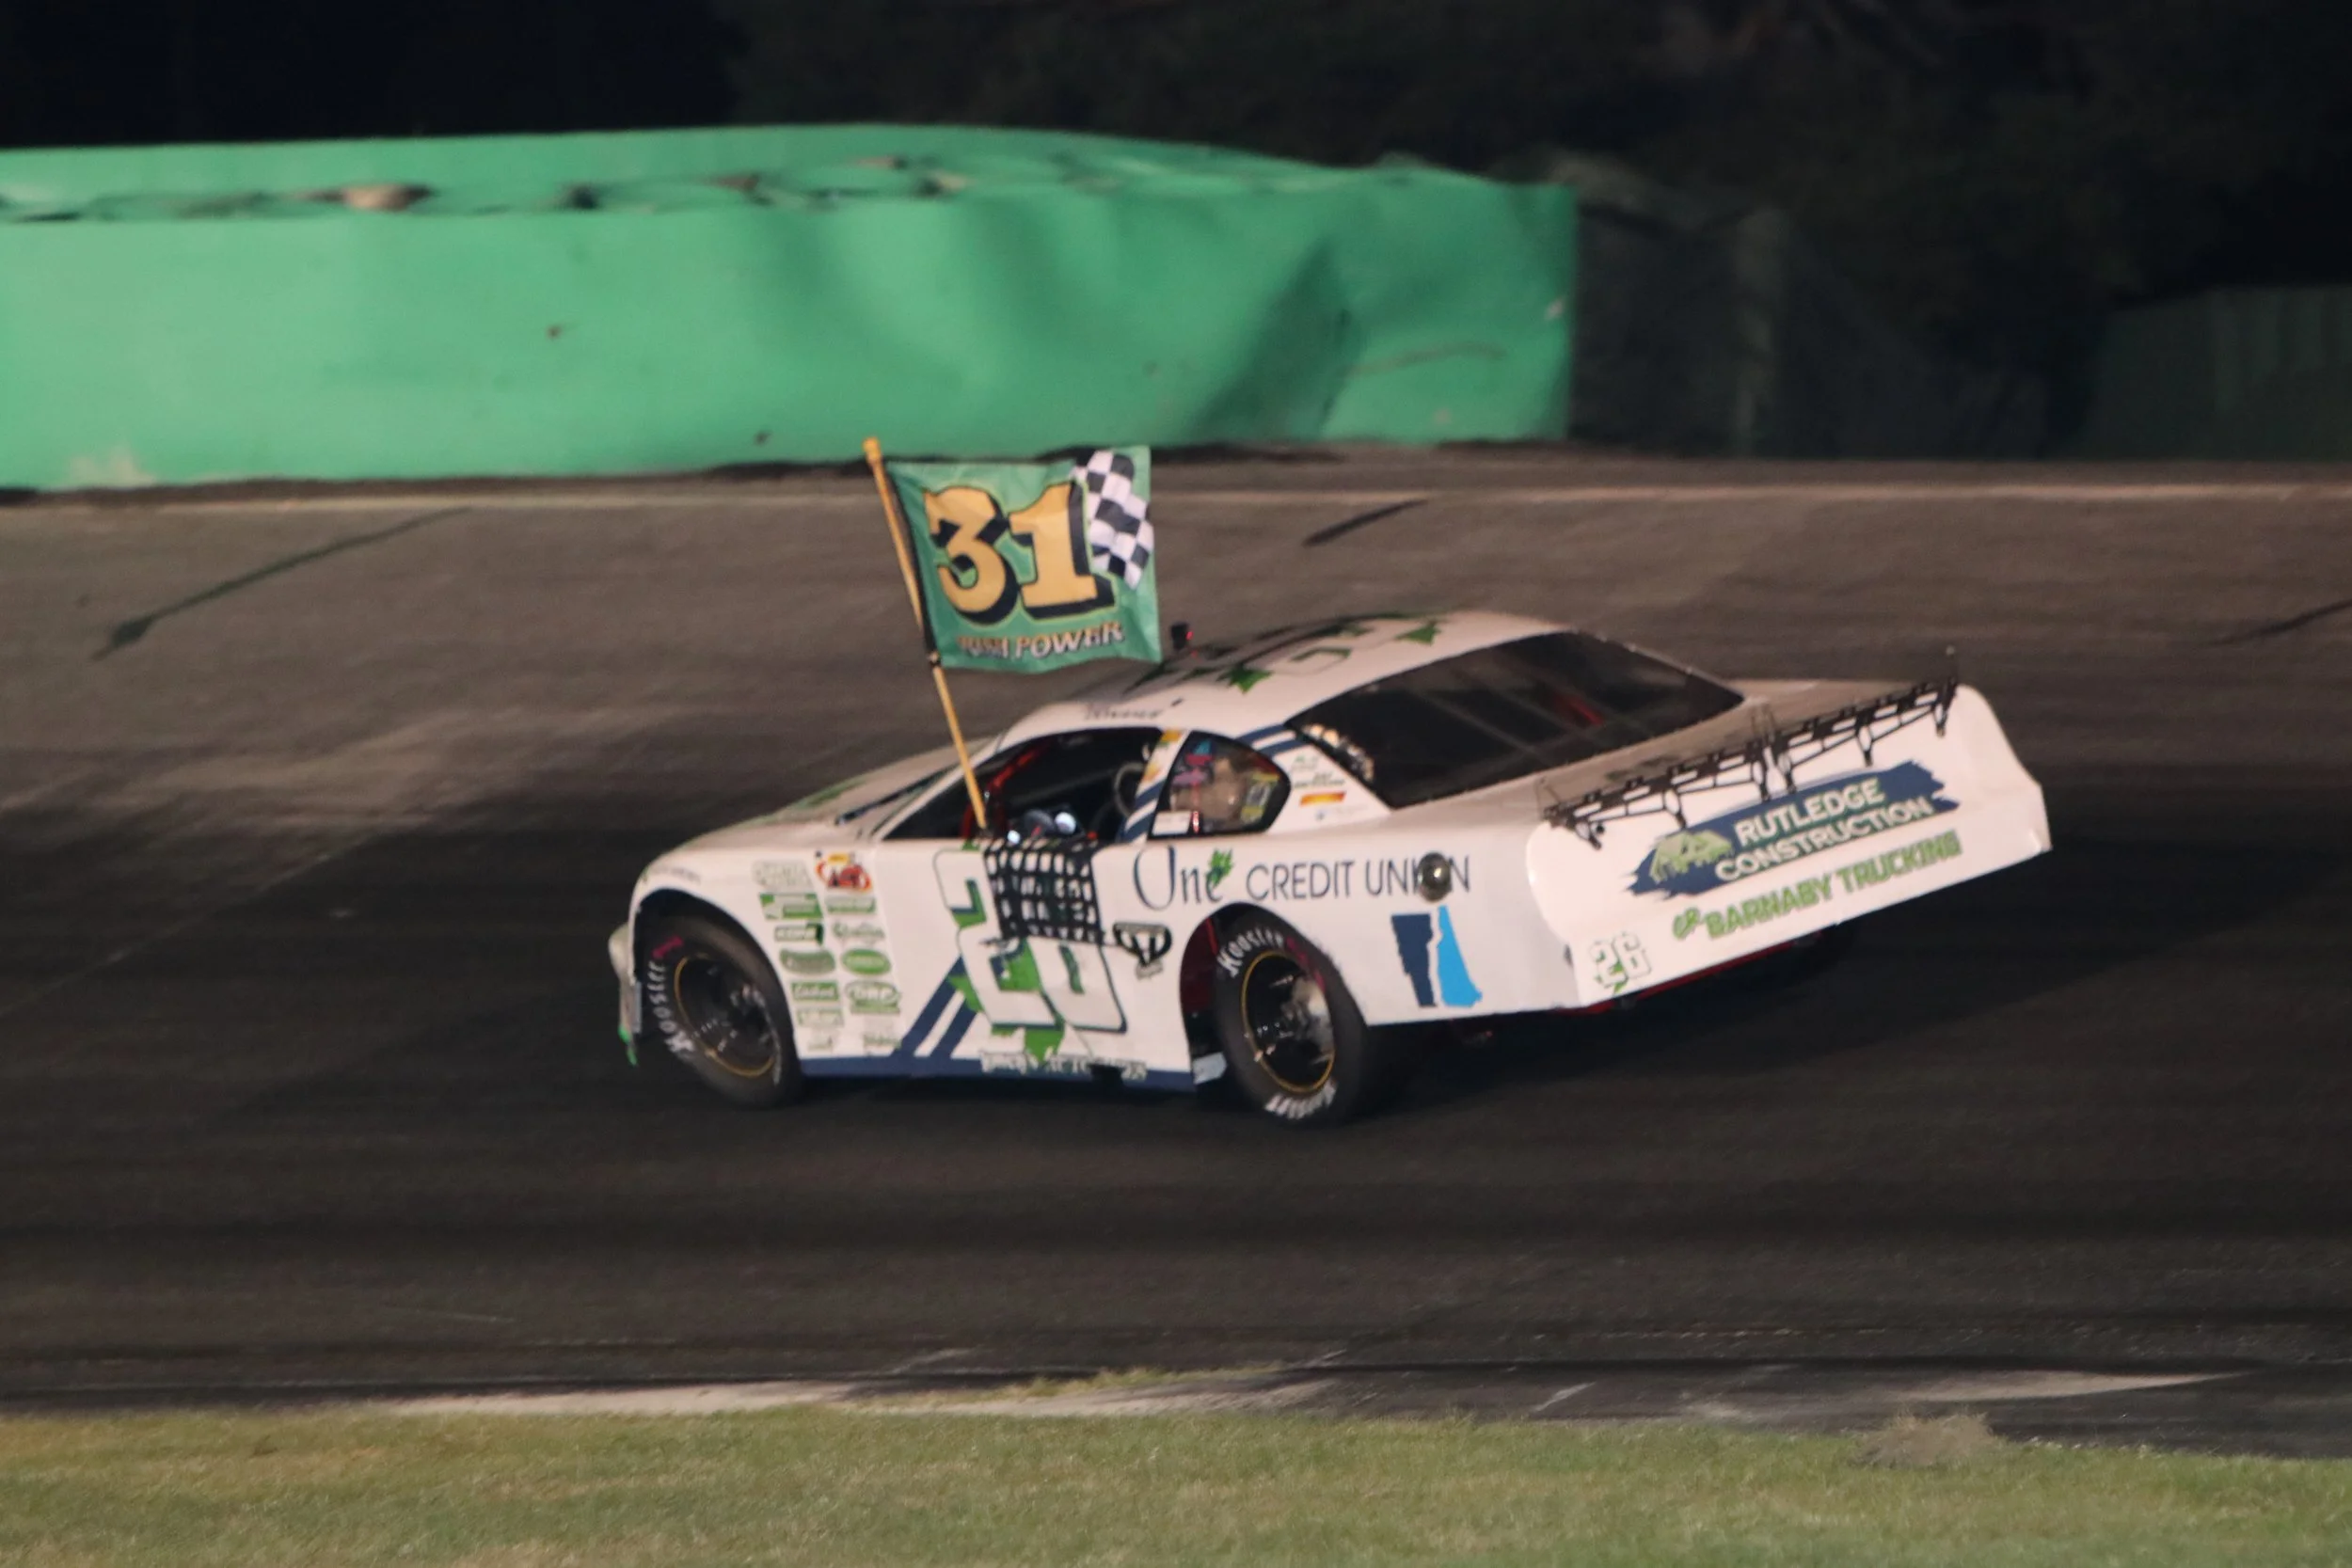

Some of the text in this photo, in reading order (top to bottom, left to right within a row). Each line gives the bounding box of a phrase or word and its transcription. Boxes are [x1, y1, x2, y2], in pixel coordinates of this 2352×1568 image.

[923, 479, 1116, 626] 31
[1015, 621, 1125, 659] POWER
[1714, 795, 1935, 882] CONSTRUCTION
[1733, 777, 1885, 847] RUTLEDGE
[1134, 846, 1471, 911] One CREDIT UNIN
[1703, 871, 1834, 940] BARNABY
[1836, 830, 1963, 894] TRUCKING
[1588, 931, 1652, 988] 26
